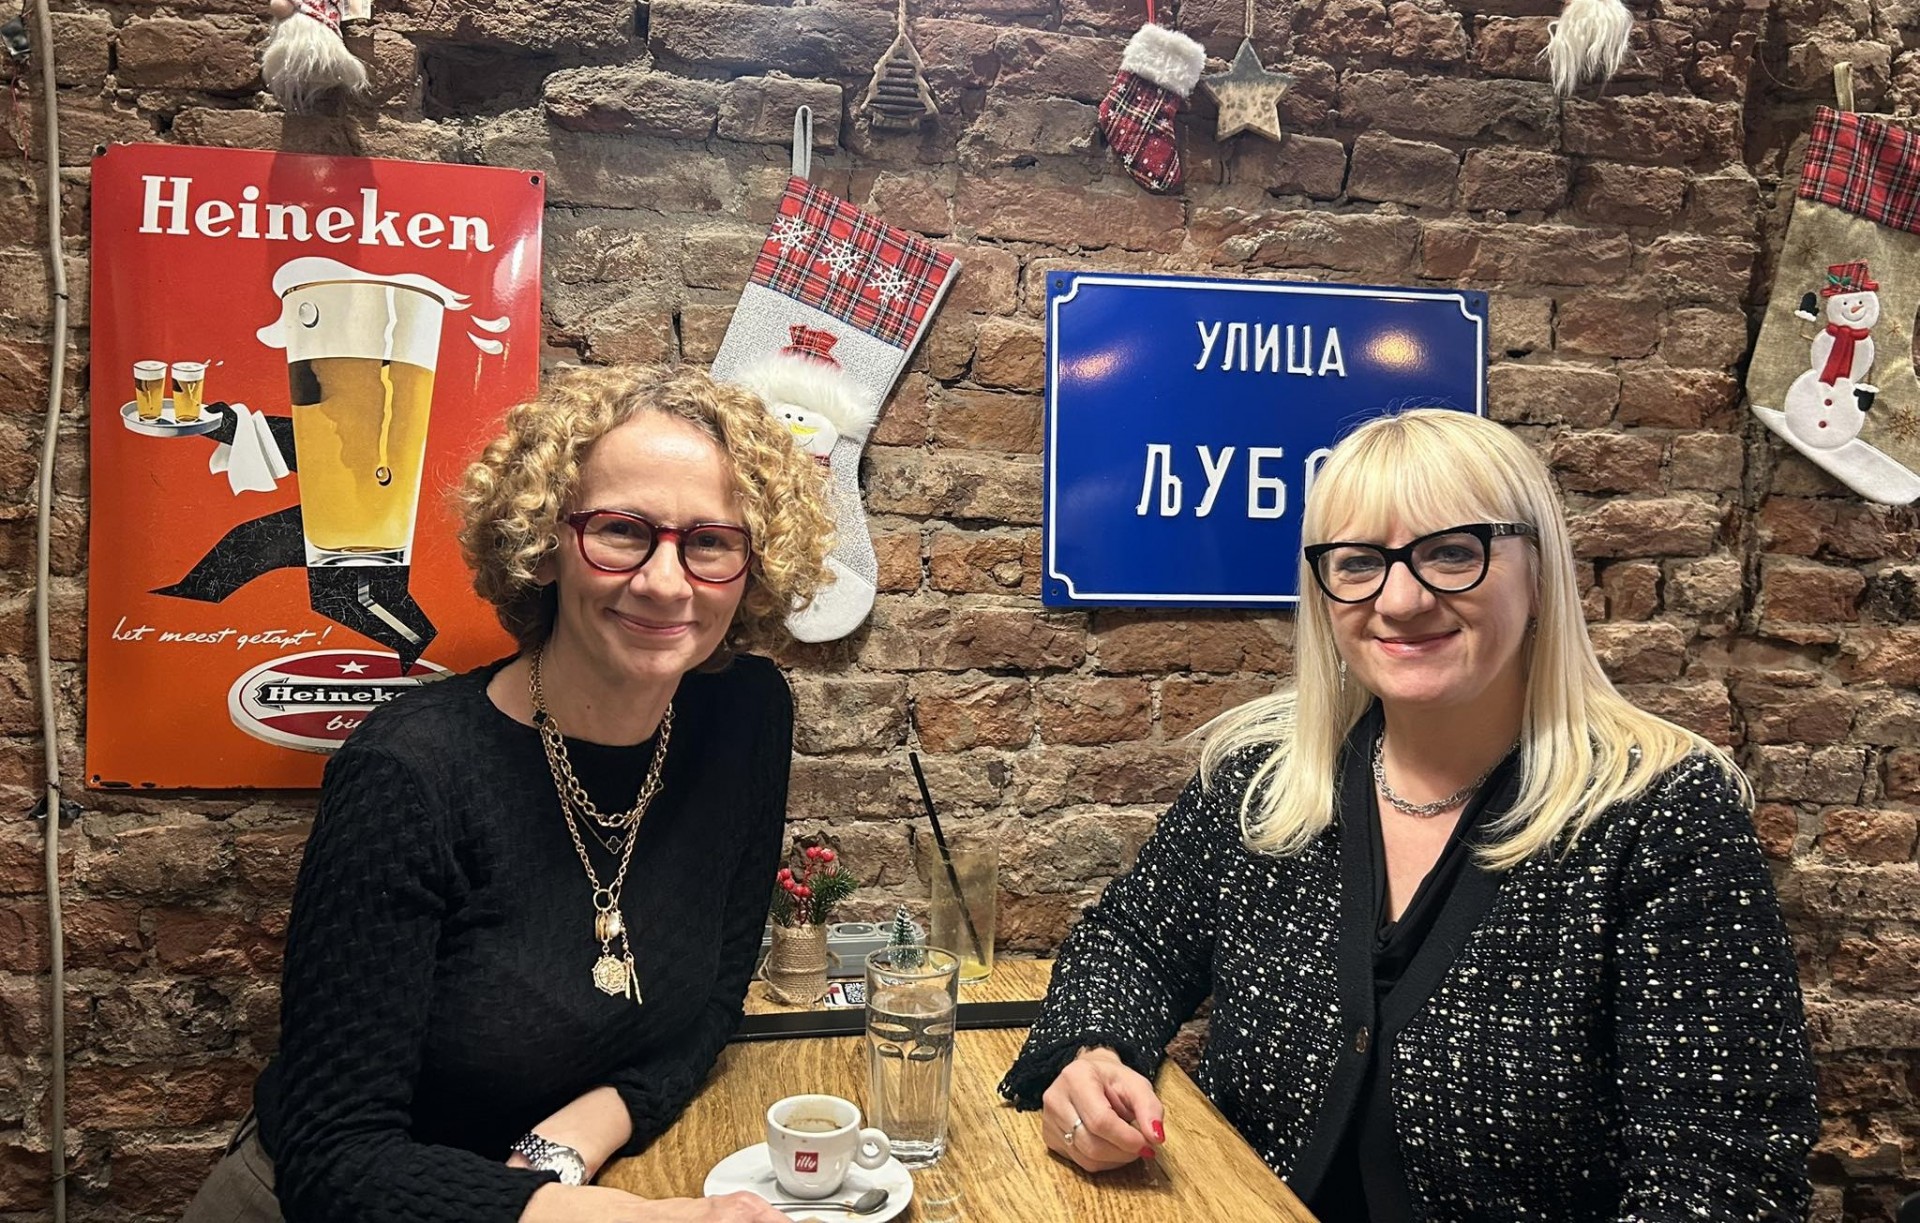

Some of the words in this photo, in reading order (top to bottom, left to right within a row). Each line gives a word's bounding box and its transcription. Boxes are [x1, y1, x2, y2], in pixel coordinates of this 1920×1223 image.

[138, 175, 495, 252] Heineken
[1194, 320, 1348, 377] УЛИЦА
[159, 627, 237, 643] meest
[267, 686, 405, 702] Heinek
[796, 1155, 817, 1169] illy
